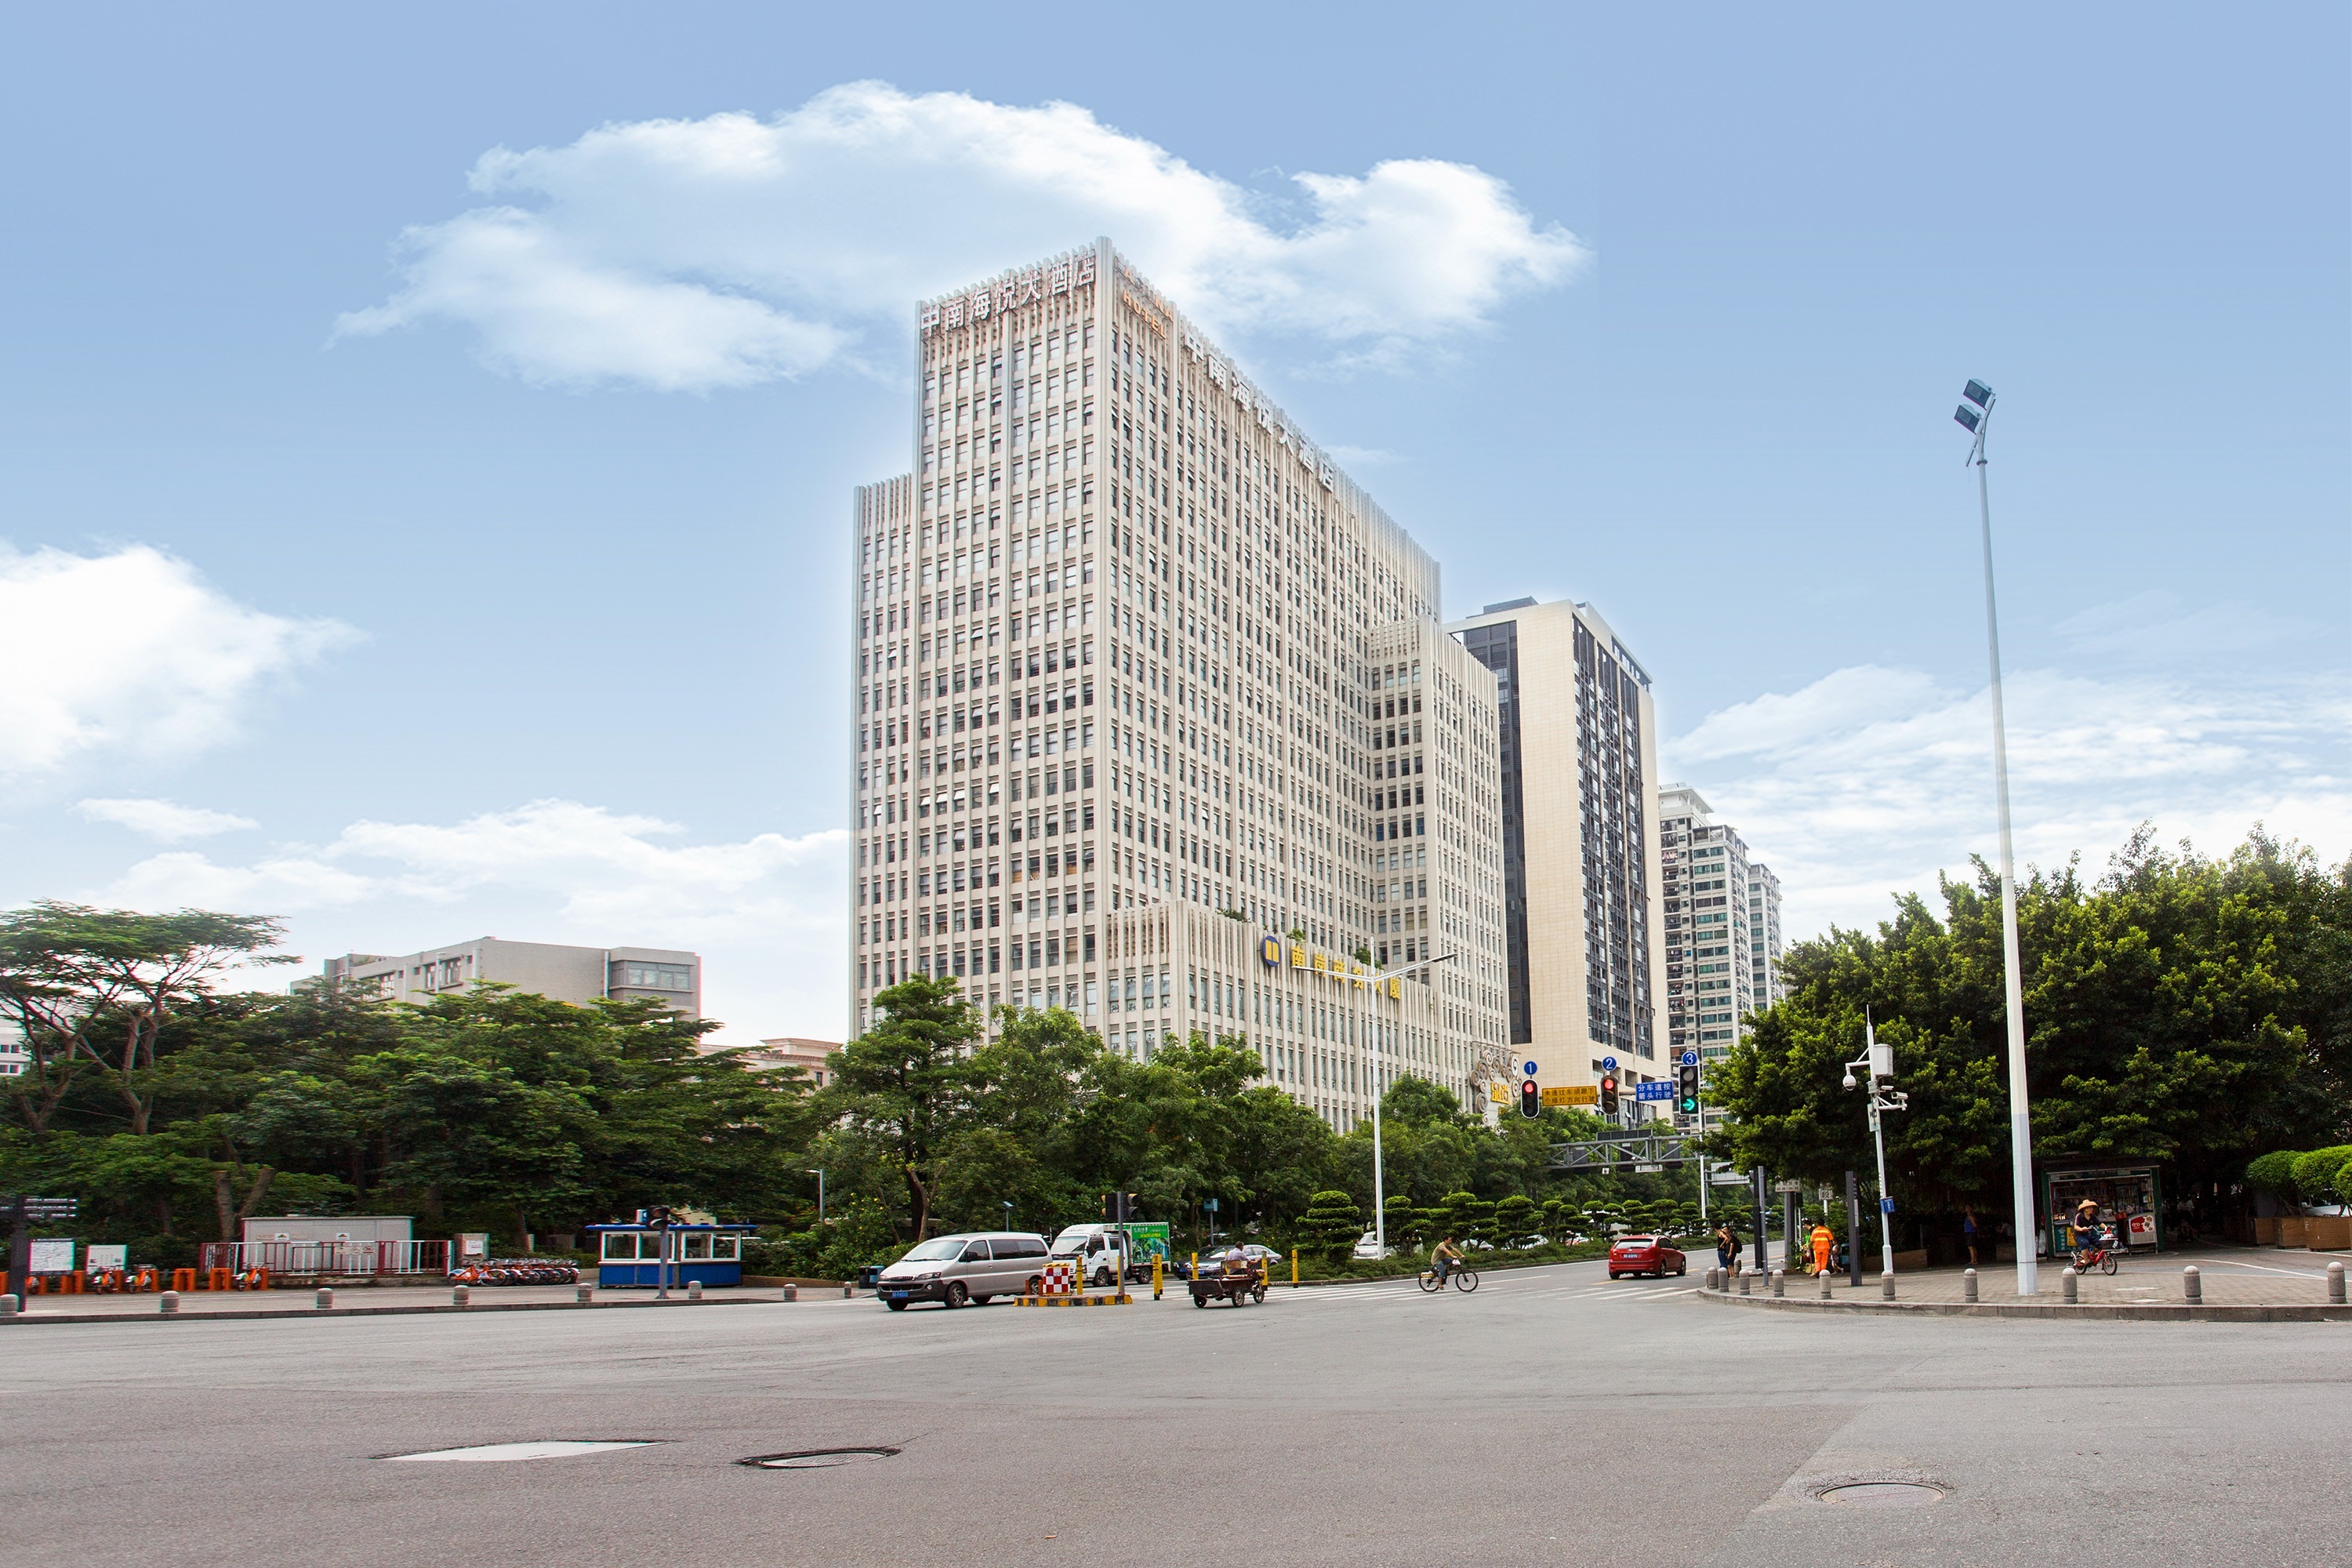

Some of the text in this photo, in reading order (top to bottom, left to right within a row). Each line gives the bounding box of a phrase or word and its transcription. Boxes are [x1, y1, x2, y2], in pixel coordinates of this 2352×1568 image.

[920, 249, 1095, 337] 中南海悦大酒店
[1123, 289, 1166, 339] HOTEL
[1184, 329, 1334, 493] 中南海悦大酒店
[1606, 1058, 1613, 1069] 2
[1686, 1053, 1693, 1065] 3
